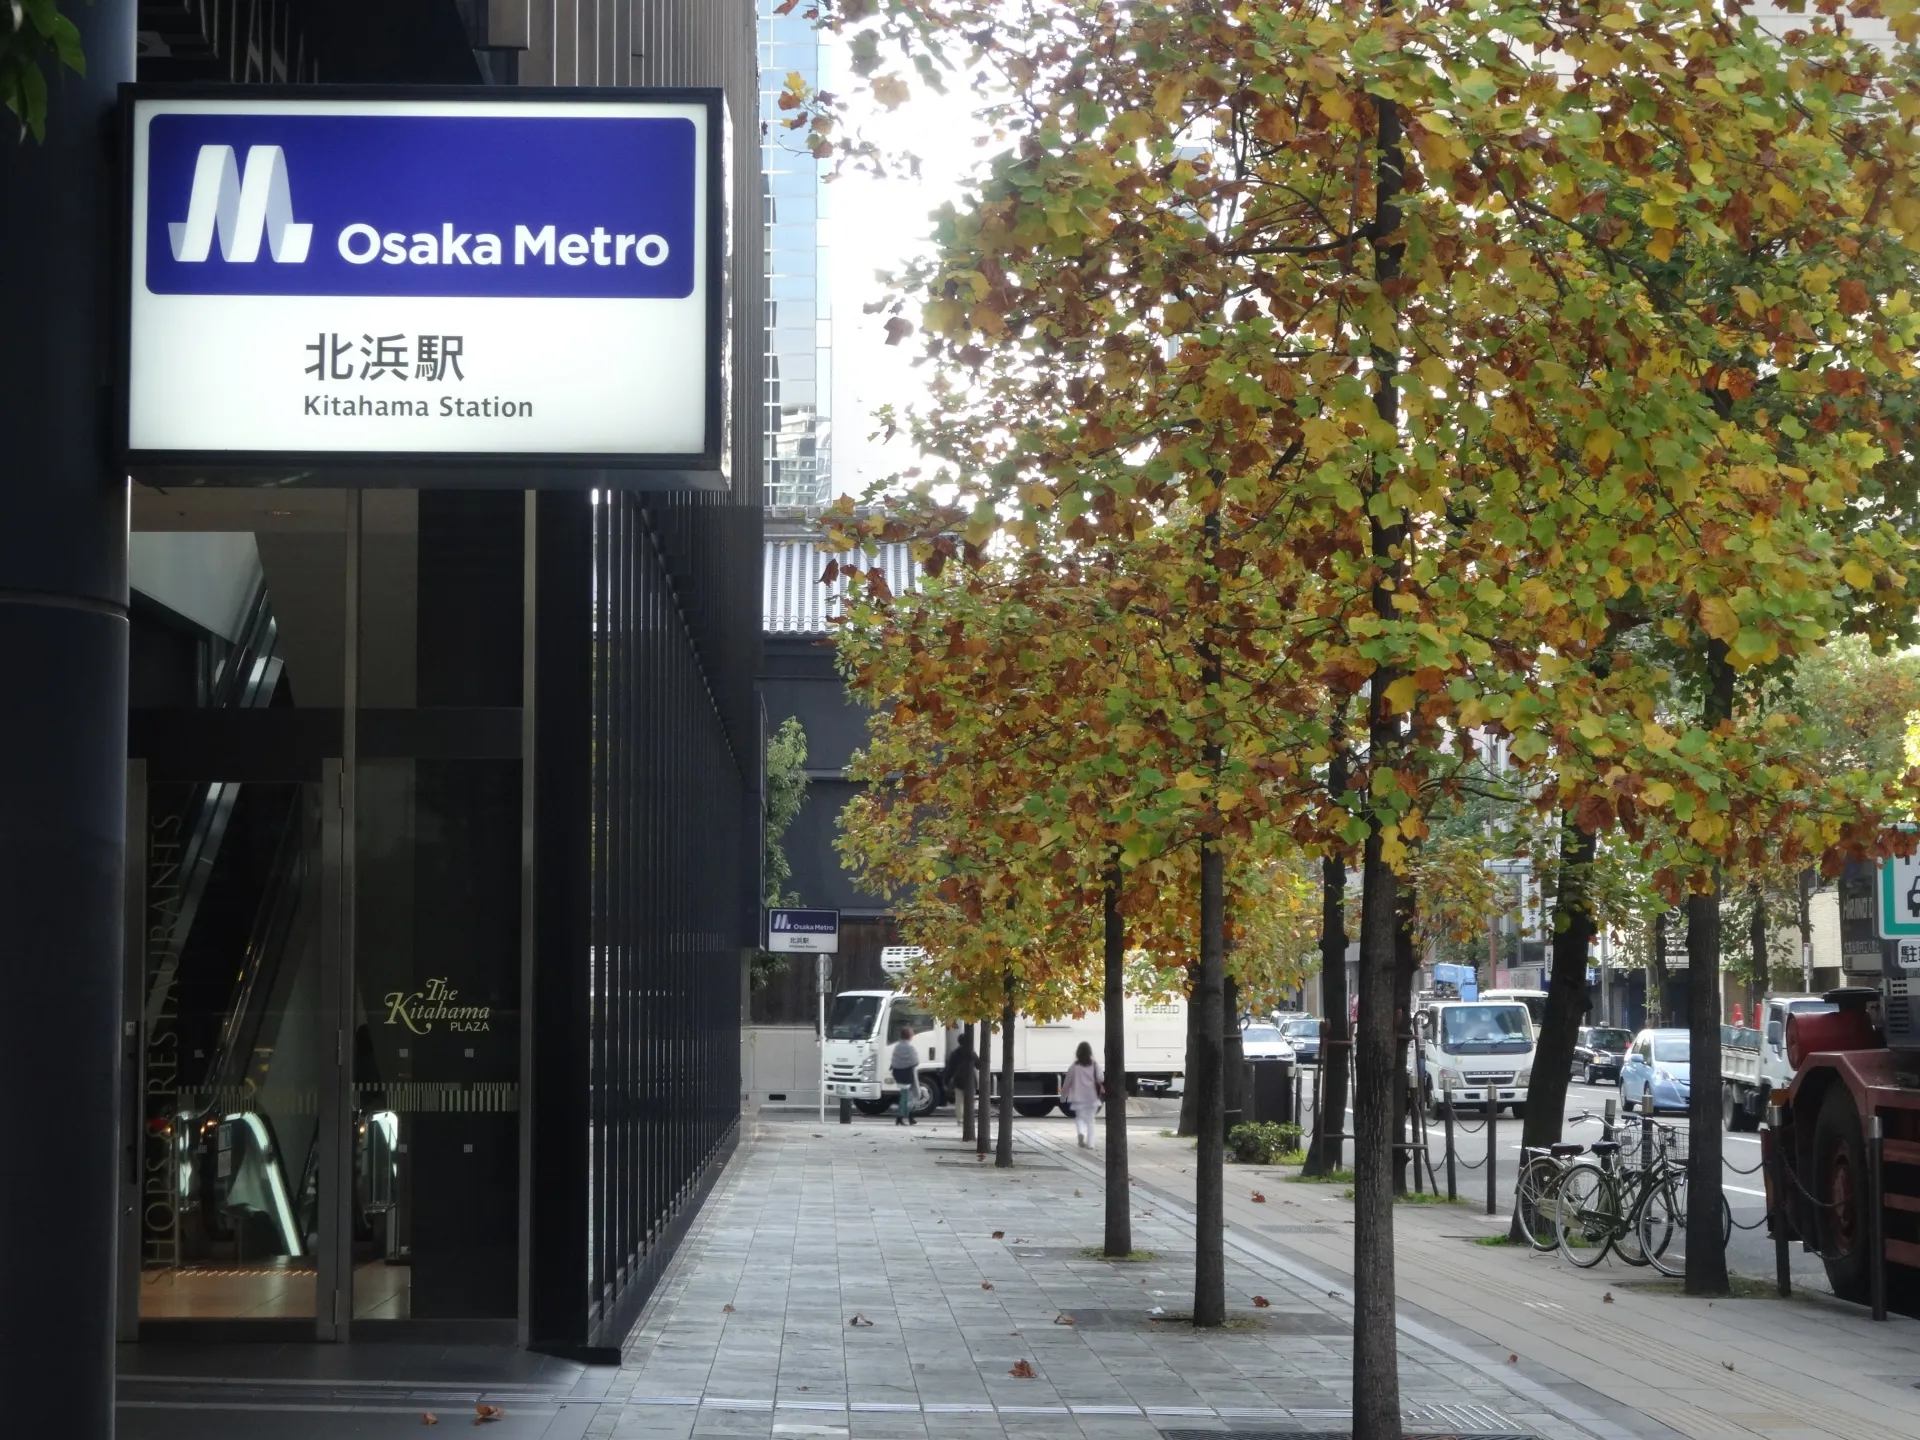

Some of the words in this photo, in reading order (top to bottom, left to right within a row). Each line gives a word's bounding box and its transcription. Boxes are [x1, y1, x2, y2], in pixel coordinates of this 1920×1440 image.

[337, 222, 502, 265] Osaka
[515, 224, 669, 266] Metro
[304, 332, 465, 382] 北浜駅
[304, 394, 429, 417] Kitahama
[439, 395, 533, 417] Station
[148, 813, 183, 1096] RESTAURANTS
[1900, 945, 1920, 963] 駐
[425, 976, 459, 1001] The
[383, 992, 490, 1035] Kitahama
[450, 1021, 490, 1032] PLAZA
[144, 1156, 178, 1287] SHOPS
